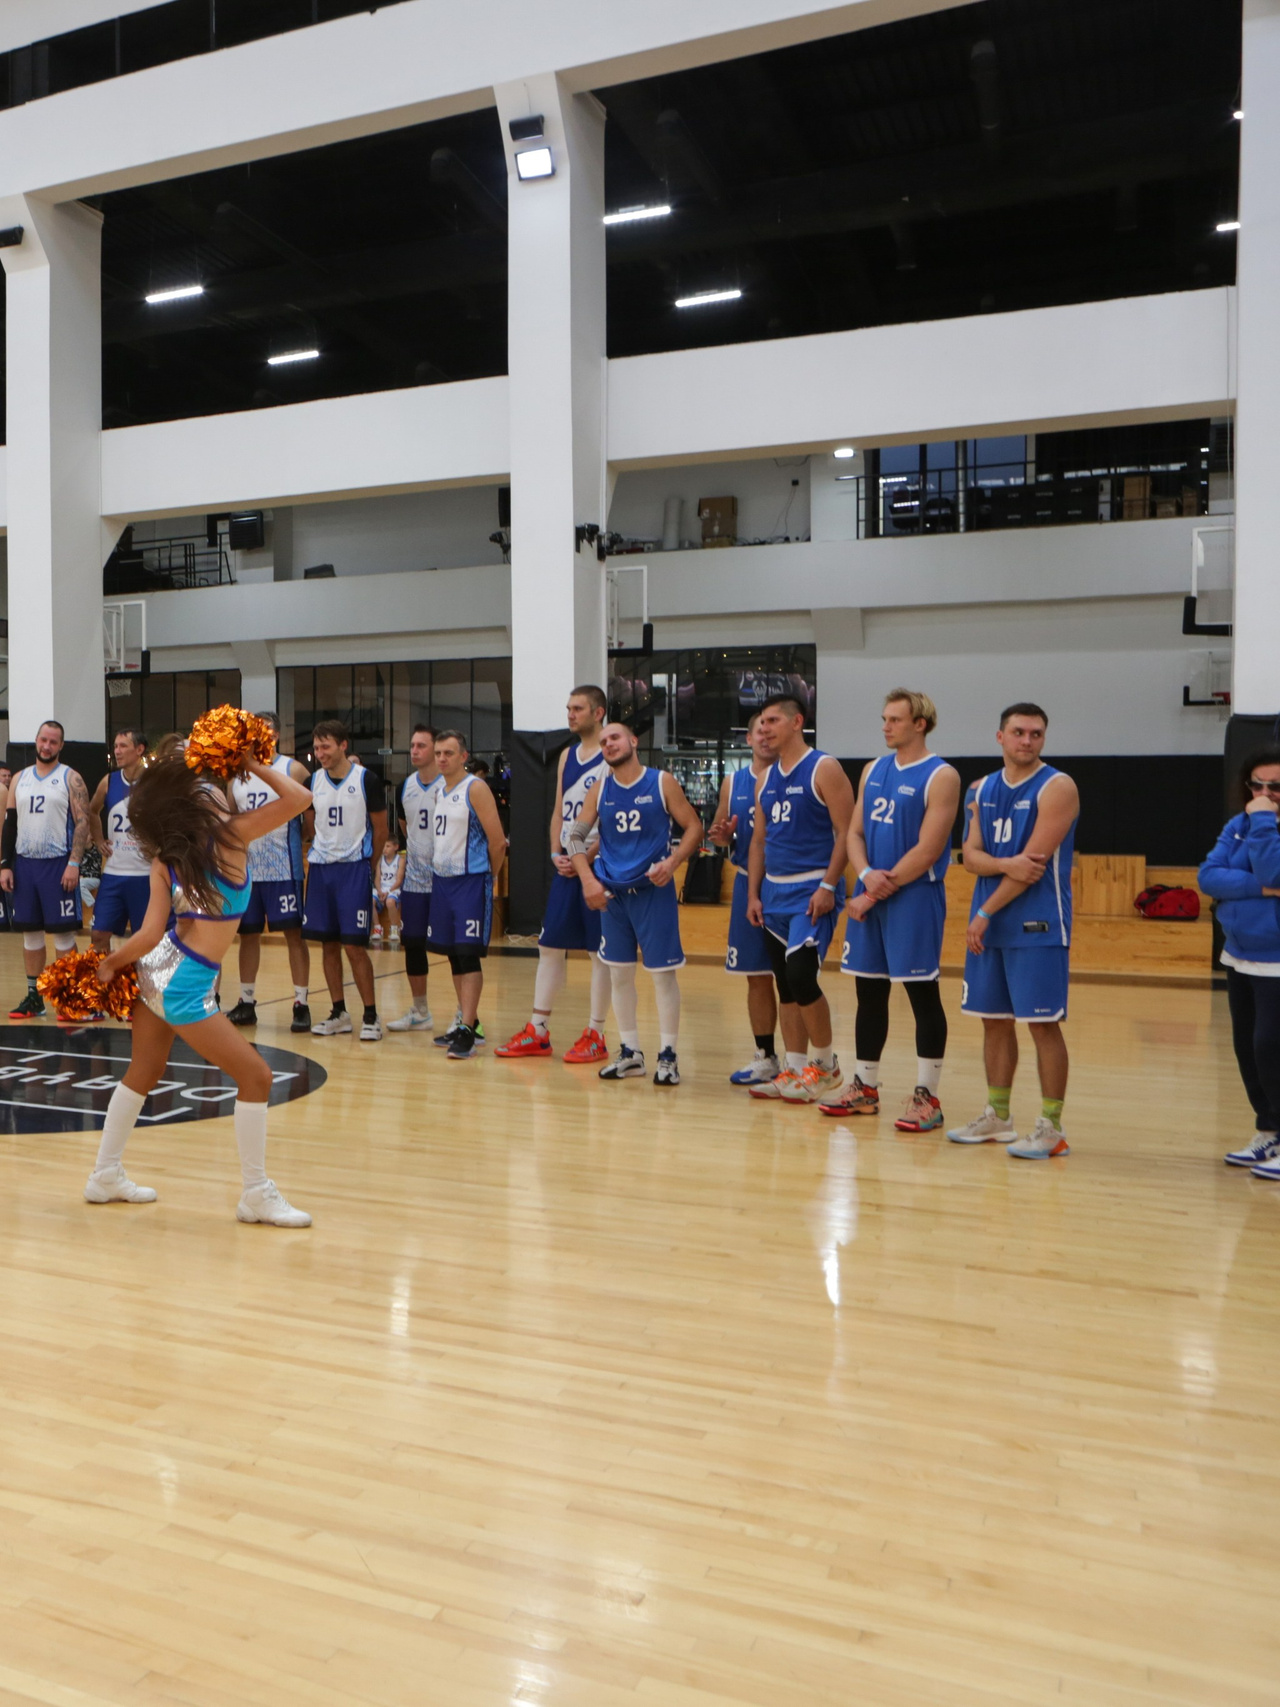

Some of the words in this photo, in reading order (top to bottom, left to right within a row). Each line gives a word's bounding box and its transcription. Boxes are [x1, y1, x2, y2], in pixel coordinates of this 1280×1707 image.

[29, 795, 45, 813] 12
[246, 792, 268, 811] 32
[771, 800, 791, 824] 92
[870, 797, 895, 824] 22
[328, 806, 344, 827] 91
[435, 815, 447, 836] 21
[615, 809, 642, 833] 32
[992, 817, 1013, 844] 10
[60, 899, 75, 917] 12
[279, 894, 298, 914] 32
[357, 909, 368, 929] 91
[465, 920, 480, 938] 21
[727, 946, 738, 968] 3
